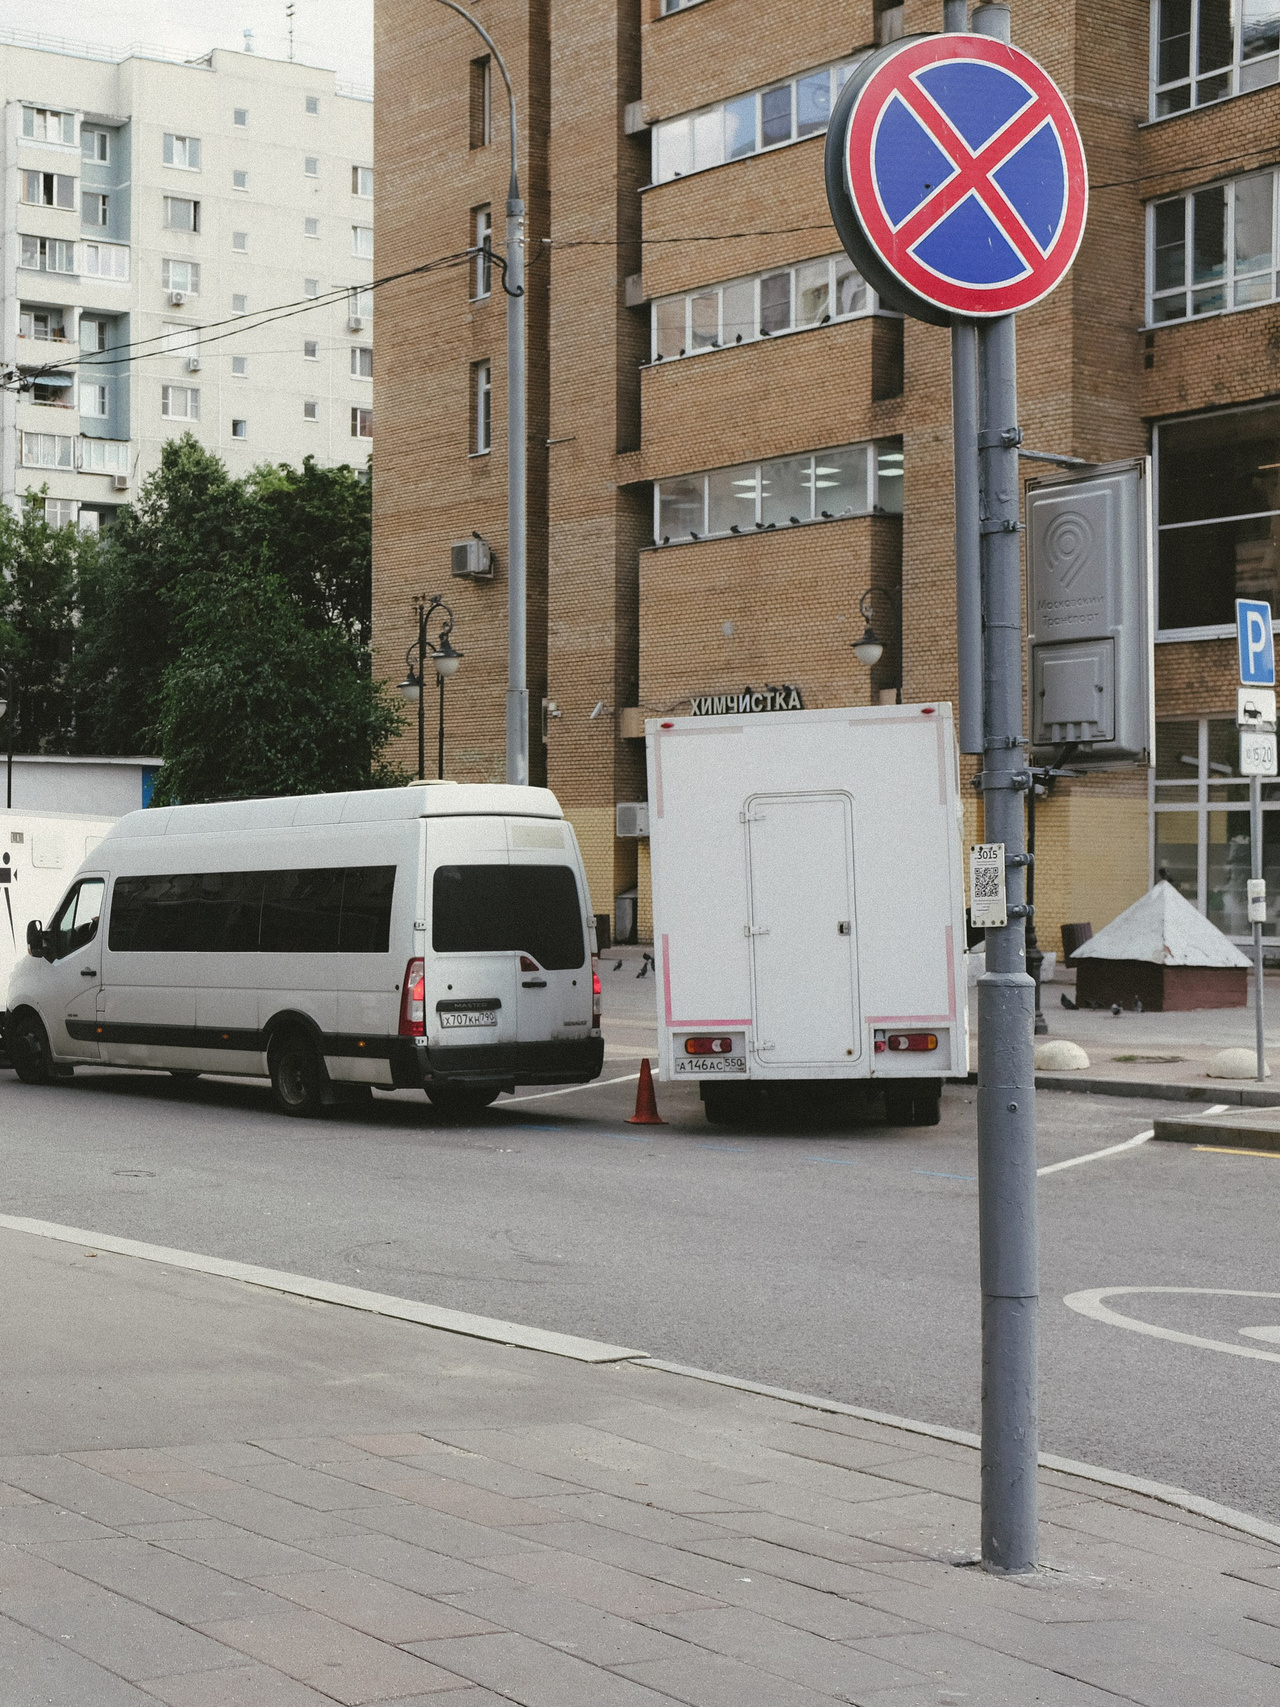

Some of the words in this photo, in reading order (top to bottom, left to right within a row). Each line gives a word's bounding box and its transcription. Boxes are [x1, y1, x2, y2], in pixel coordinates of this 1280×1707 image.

[1246, 610, 1266, 675] P
[690, 690, 801, 716] ХИМЧИСТКА
[1262, 746, 1272, 762] 20
[977, 850, 998, 860] 3015
